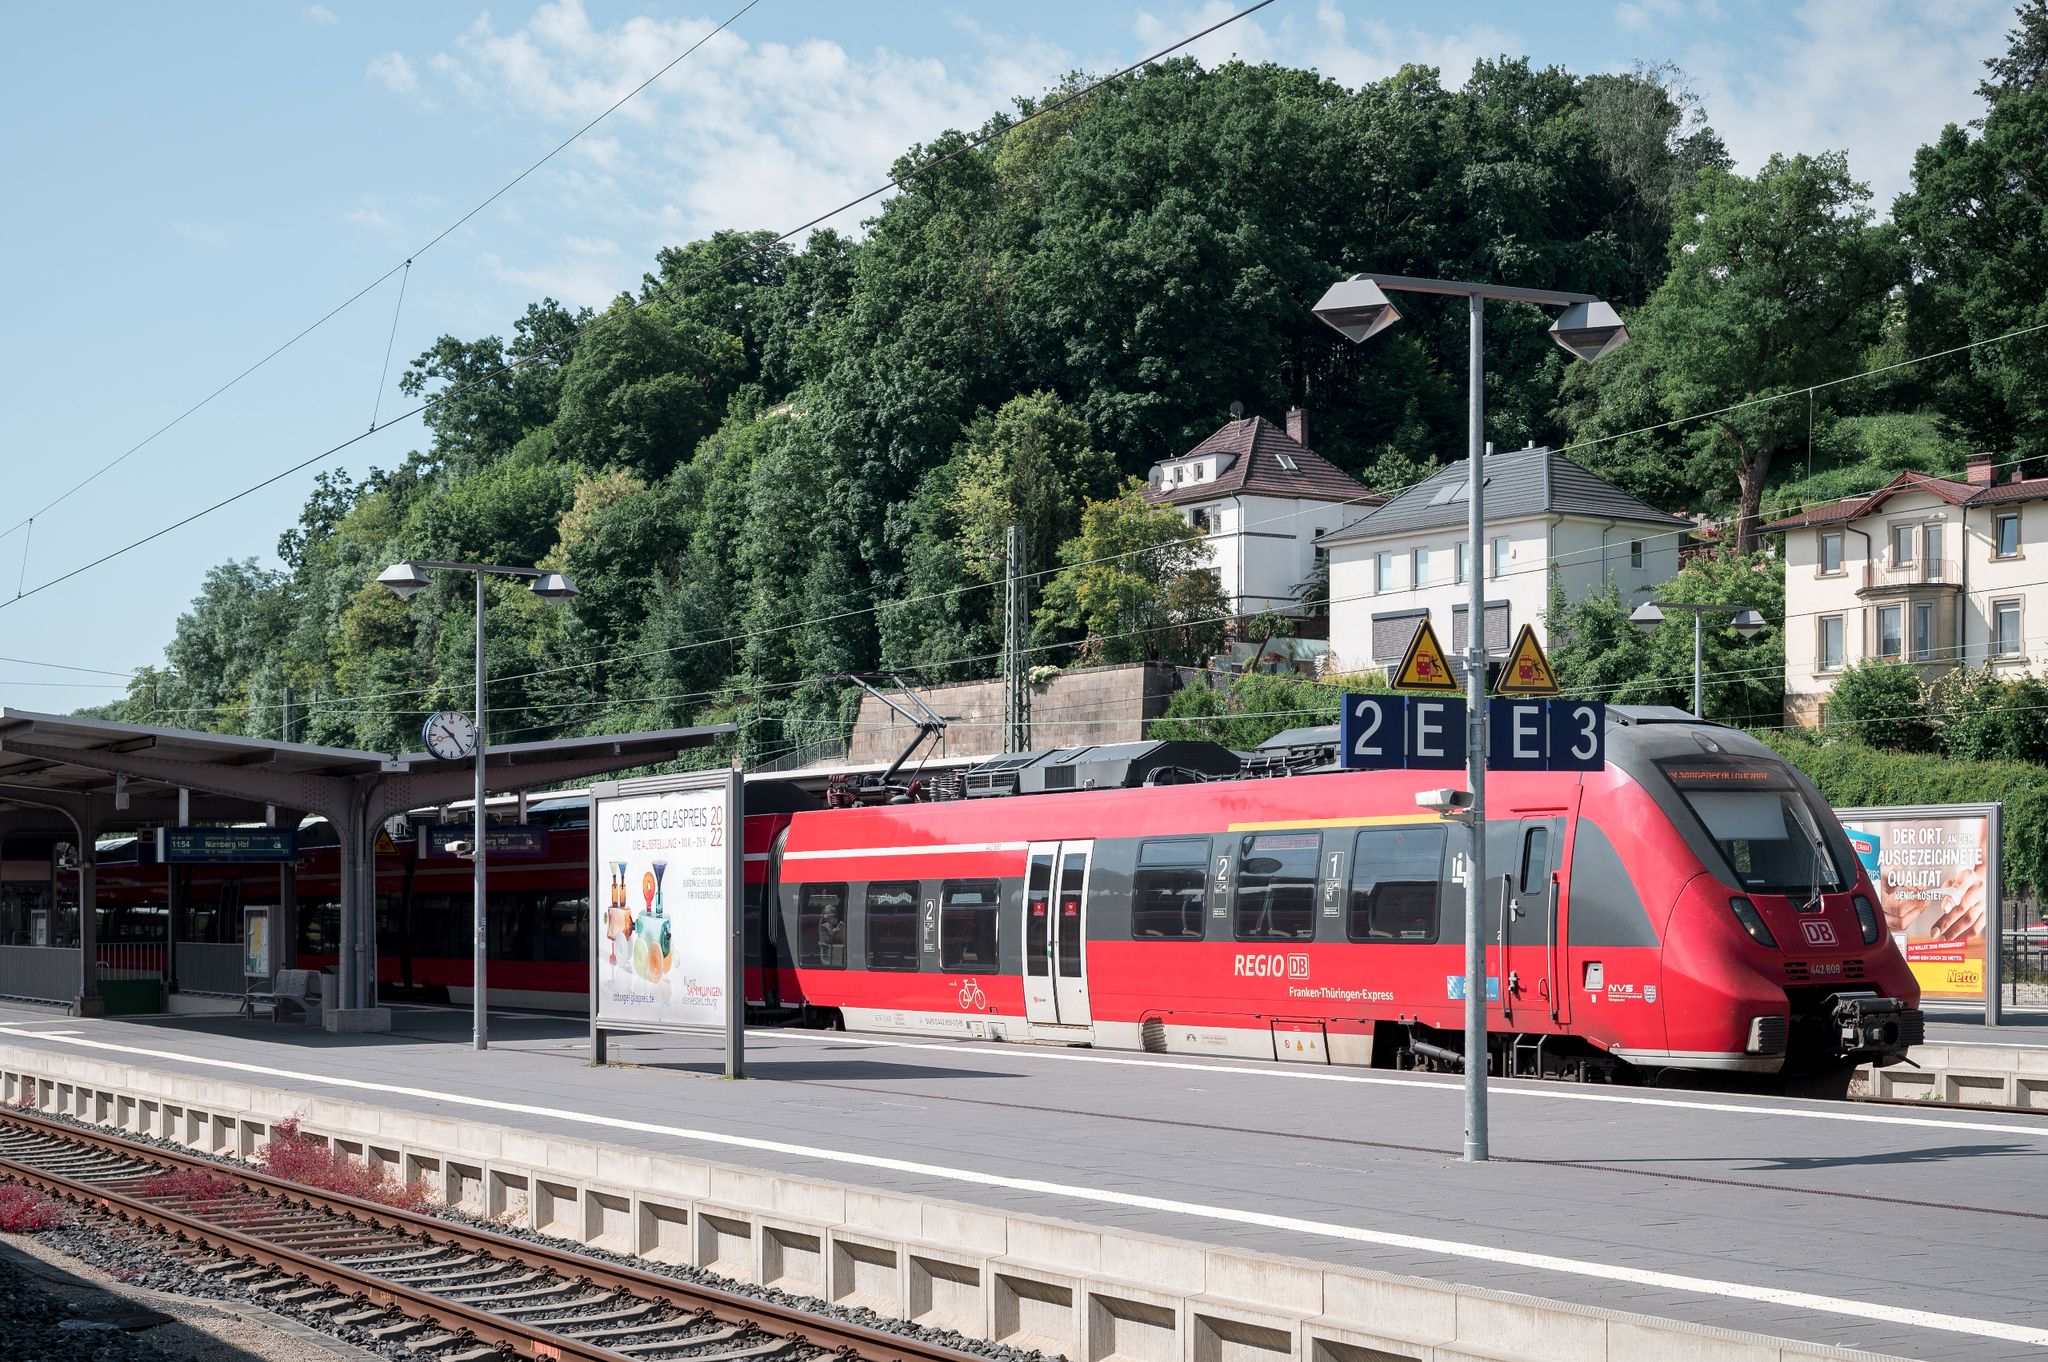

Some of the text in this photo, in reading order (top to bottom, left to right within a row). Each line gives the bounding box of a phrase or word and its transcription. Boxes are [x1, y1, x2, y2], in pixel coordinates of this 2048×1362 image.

[1354, 700, 1383, 756] 2
[1416, 703, 1444, 757] E
[1512, 705, 1540, 759] E
[1571, 706, 1598, 760] 3
[612, 807, 708, 833] COBURGER GLASPREIS
[710, 805, 723, 826] 20
[172, 840, 191, 848] 11:54
[205, 840, 250, 850] Nürnberg Hbf
[710, 827, 723, 847] 22
[1892, 828, 1916, 845] DER
[1947, 834, 1957, 845] AN
[1959, 833, 1976, 845] DEM
[1330, 854, 1340, 878] 1
[1876, 848, 1983, 867] AUSGEZEICHNETE
[1217, 858, 1229, 881] 2
[1887, 867, 1943, 889] QUALITÄT
[926, 901, 934, 921] 2
[1803, 921, 1836, 944] DB
[1234, 954, 1308, 977] REGIO DB
[1811, 965, 1825, 975] 442
[1947, 969, 1979, 983] Netto
[1288, 986, 1395, 1003] Franken-Thüringen-Express
[1608, 984, 1634, 993] NVS
